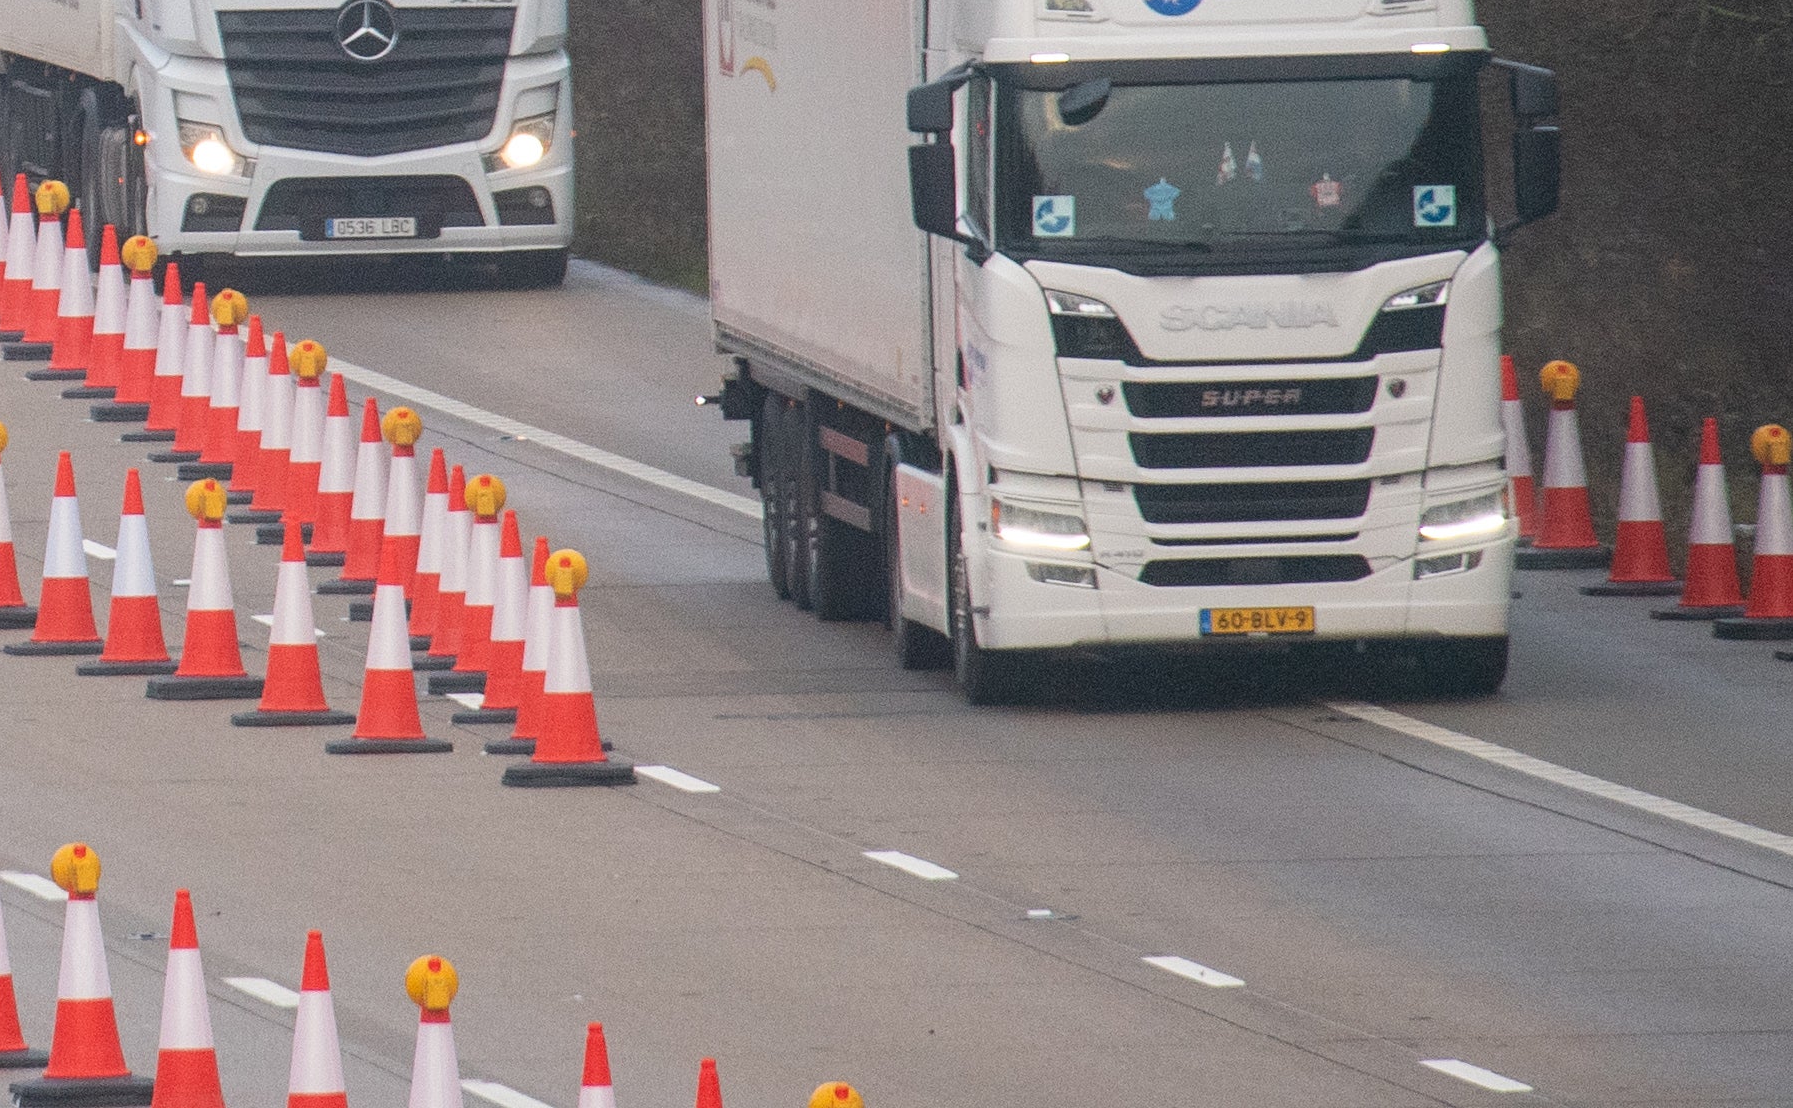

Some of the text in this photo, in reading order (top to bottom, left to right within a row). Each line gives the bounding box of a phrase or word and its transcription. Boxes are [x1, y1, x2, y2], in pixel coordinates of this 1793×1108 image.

[1159, 302, 1339, 332] SCANIA
[1201, 389, 1300, 407] SUPER
[1217, 610, 1306, 629] 60-BLV-9
